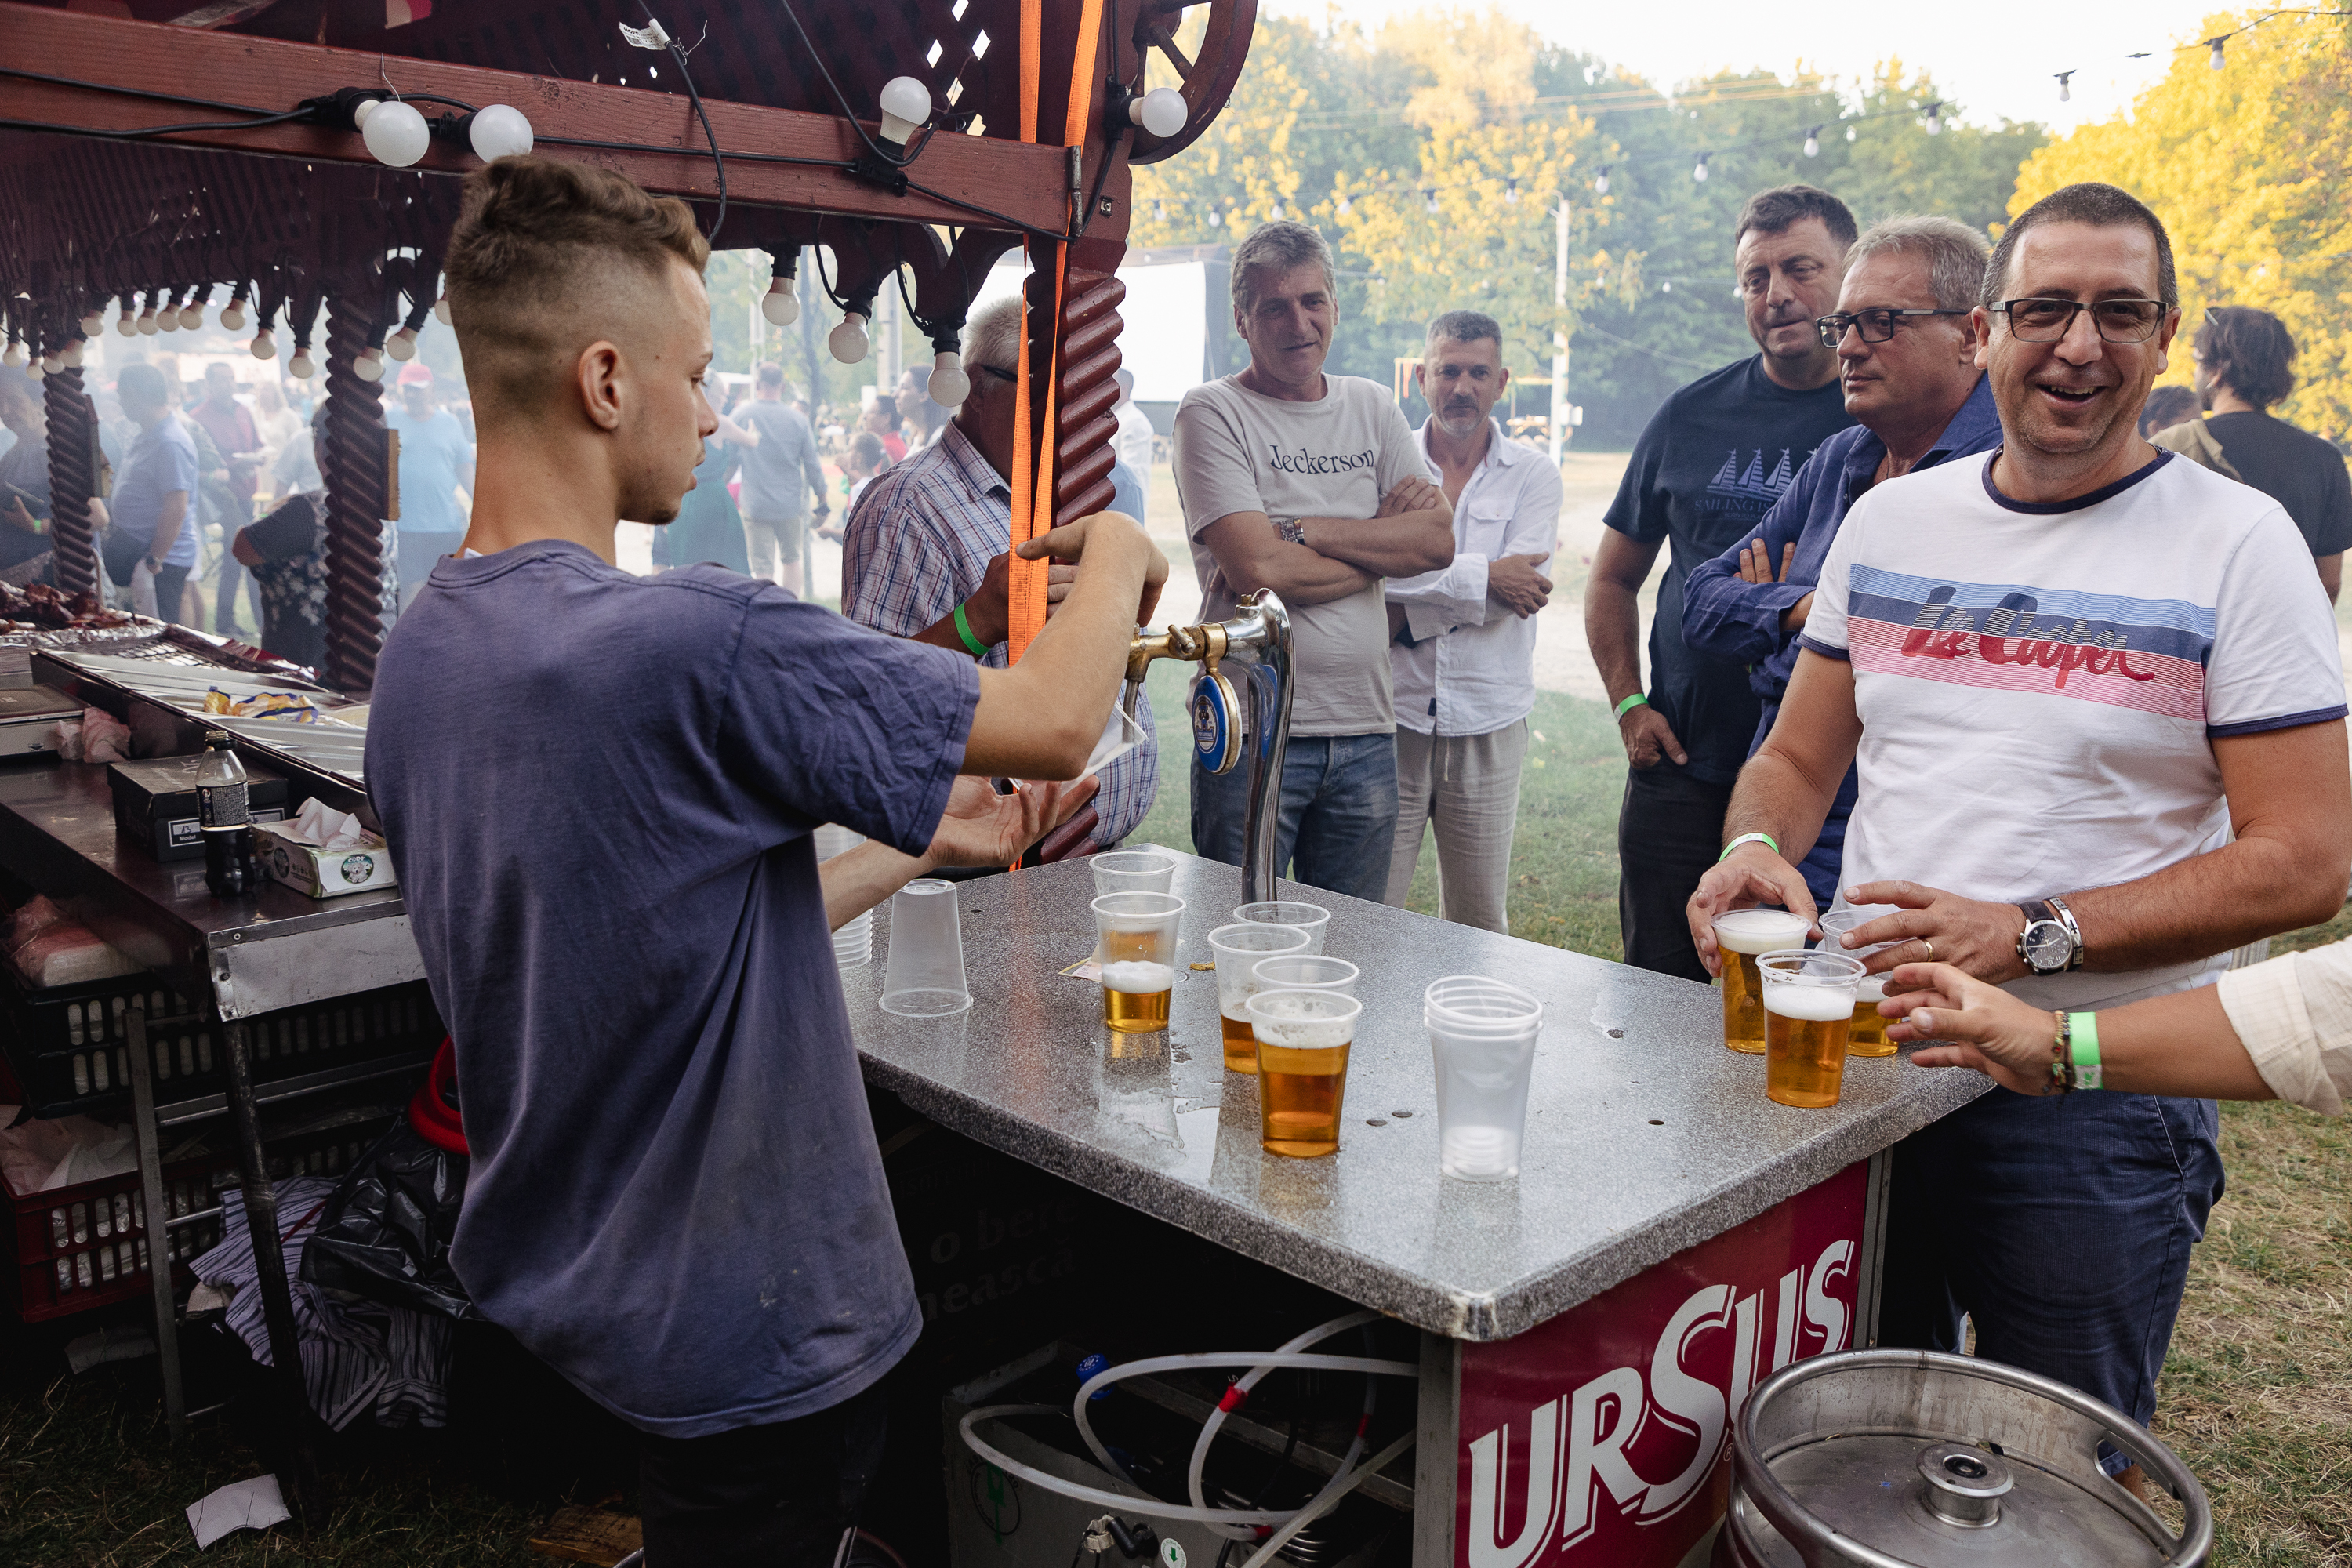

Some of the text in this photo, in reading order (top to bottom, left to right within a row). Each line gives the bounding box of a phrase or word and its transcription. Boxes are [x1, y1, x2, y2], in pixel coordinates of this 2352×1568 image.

[1269, 445, 1374, 474] Jeckerson
[1694, 498, 1754, 512] SAILING
[1978, 592, 2155, 688] Cooper
[1468, 1239, 1855, 1568] URSUS
